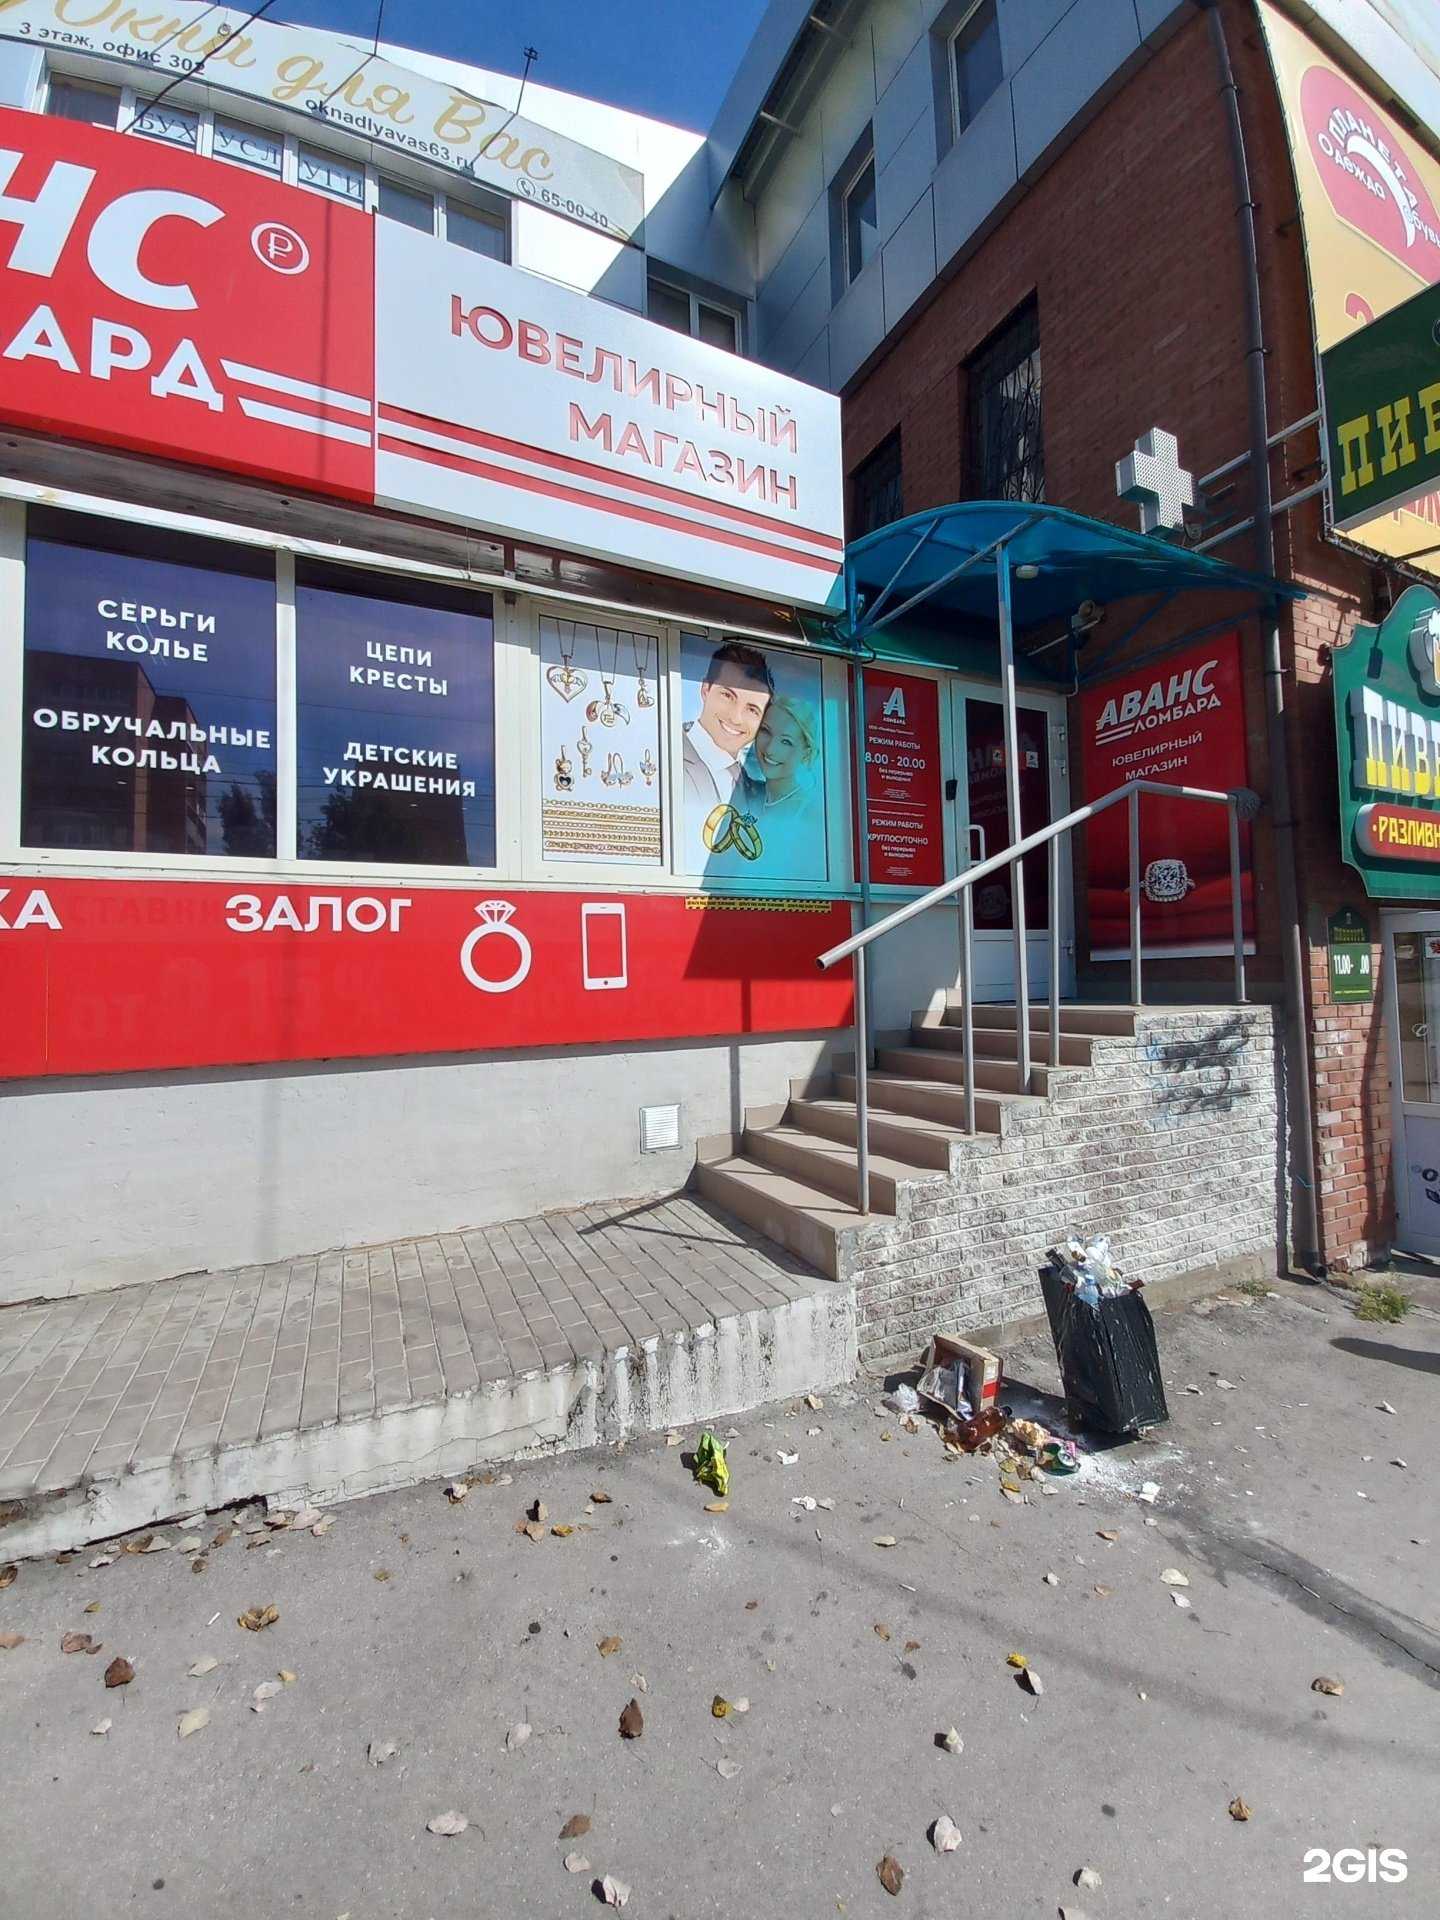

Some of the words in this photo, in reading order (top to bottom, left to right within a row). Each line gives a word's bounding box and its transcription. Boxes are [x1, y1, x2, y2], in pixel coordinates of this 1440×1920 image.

[18, 22, 31, 36] 3
[38, 27, 95, 49] этаж,
[102, 39, 161, 64] офис
[272, 54, 414, 124] для
[433, 95, 553, 181] Вас
[305, 99, 475, 170] oknadlyavas63.ru
[2, 303, 224, 412] АРД
[451, 294, 798, 455] ЮВЕЛИРНЫЙ
[569, 401, 798, 510] МАГАЗИН
[97, 599, 216, 633] СЕРЬГИ
[106, 631, 208, 662] КОЛЬЕ
[366, 641, 432, 667] ЦЕПИ
[349, 665, 448, 696] КРЕСТЫ
[1096, 660, 1218, 731] АВАНС
[33, 708, 271, 748] ОБРУЧАЛЬНЫЕ
[1134, 693, 1222, 733] ЛОМБАРД
[92, 745, 222, 775] КОЛЬЦА
[343, 742, 458, 770] ДЕТСКИЕ
[869, 736, 894, 747] РЕЖИМ
[894, 739, 921, 750] РАБОТЫ
[1112, 730, 1202, 767] ЮВЕЛИРНЫЙ
[897, 756, 926, 770] 20.00
[1125, 755, 1188, 781] МАГАЗИН
[323, 767, 476, 798] УКРАШЕНИЯ
[871, 818, 897, 827] РЕЖИМ
[897, 820, 924, 830] РАБОТЫ
[225, 893, 412, 932] ЗАЛОГ
